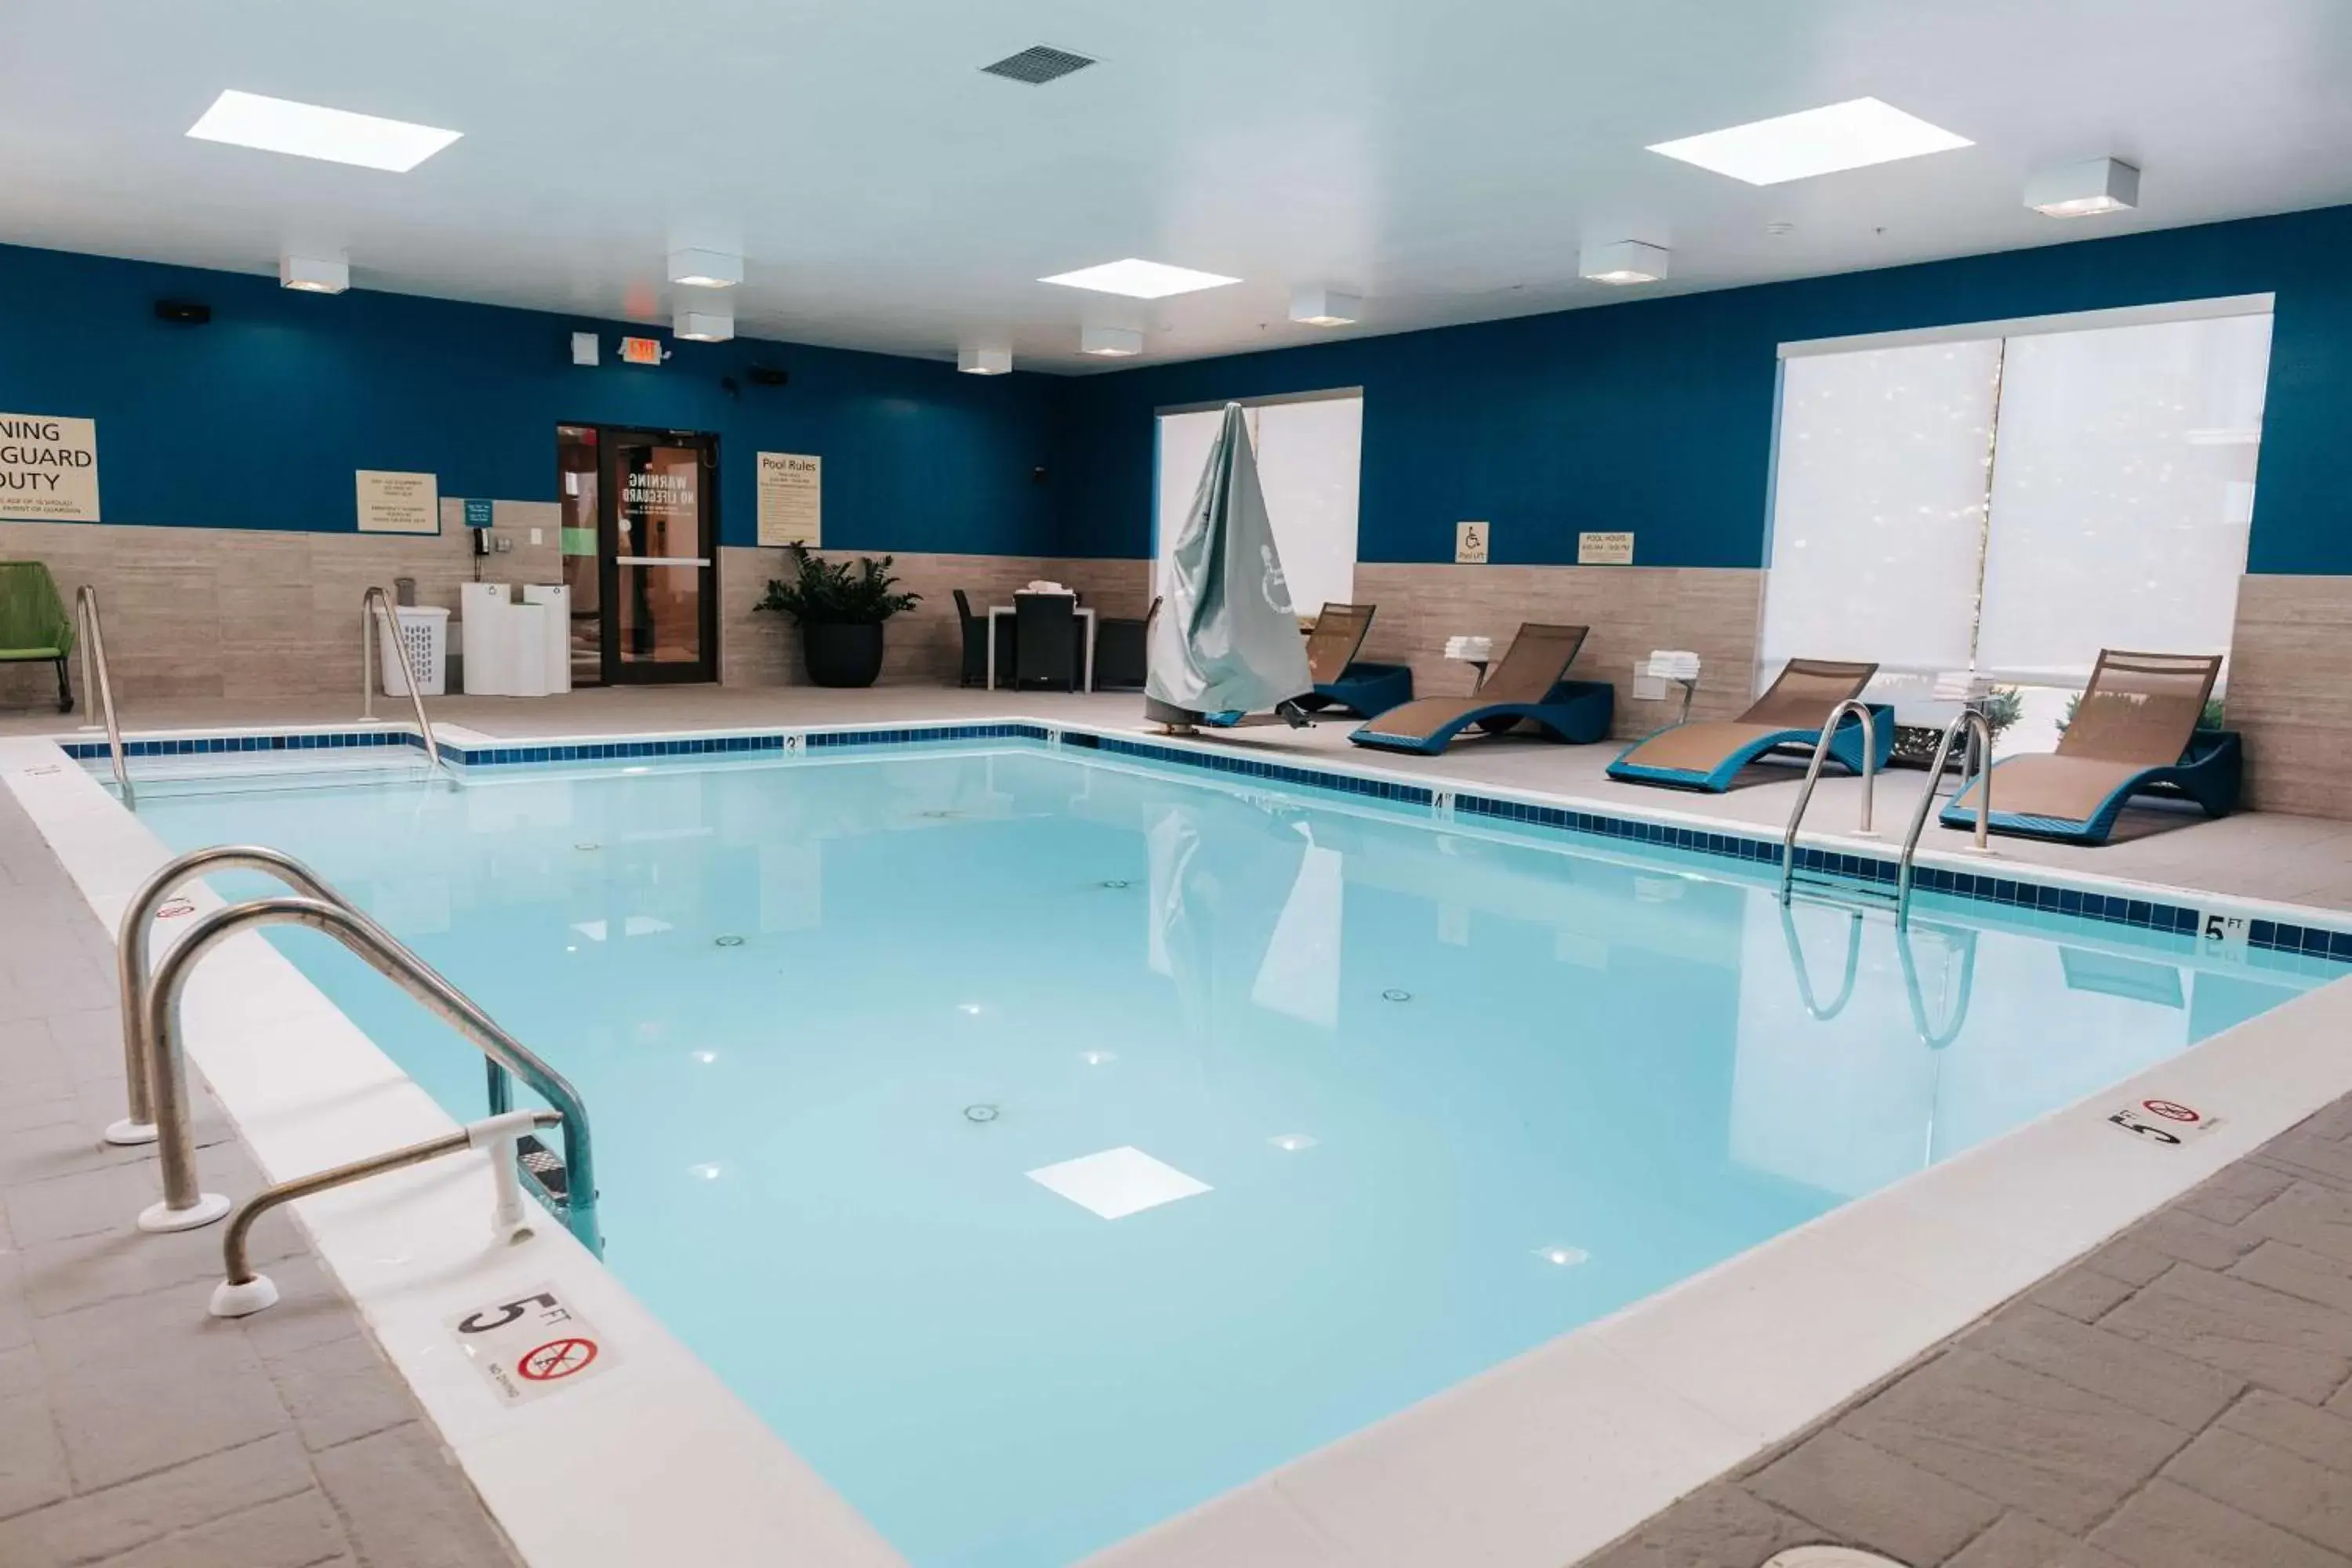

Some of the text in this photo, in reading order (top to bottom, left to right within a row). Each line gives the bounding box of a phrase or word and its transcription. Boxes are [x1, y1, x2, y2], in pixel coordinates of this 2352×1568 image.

[1, 446, 92, 468] GUARD
[763, 458, 816, 472] Pool Rules
[2205, 915, 2243, 940] 5 FT
[2108, 1115, 2181, 1145] 5
[458, 1292, 557, 1334] 5
[539, 1308, 572, 1326] FT
